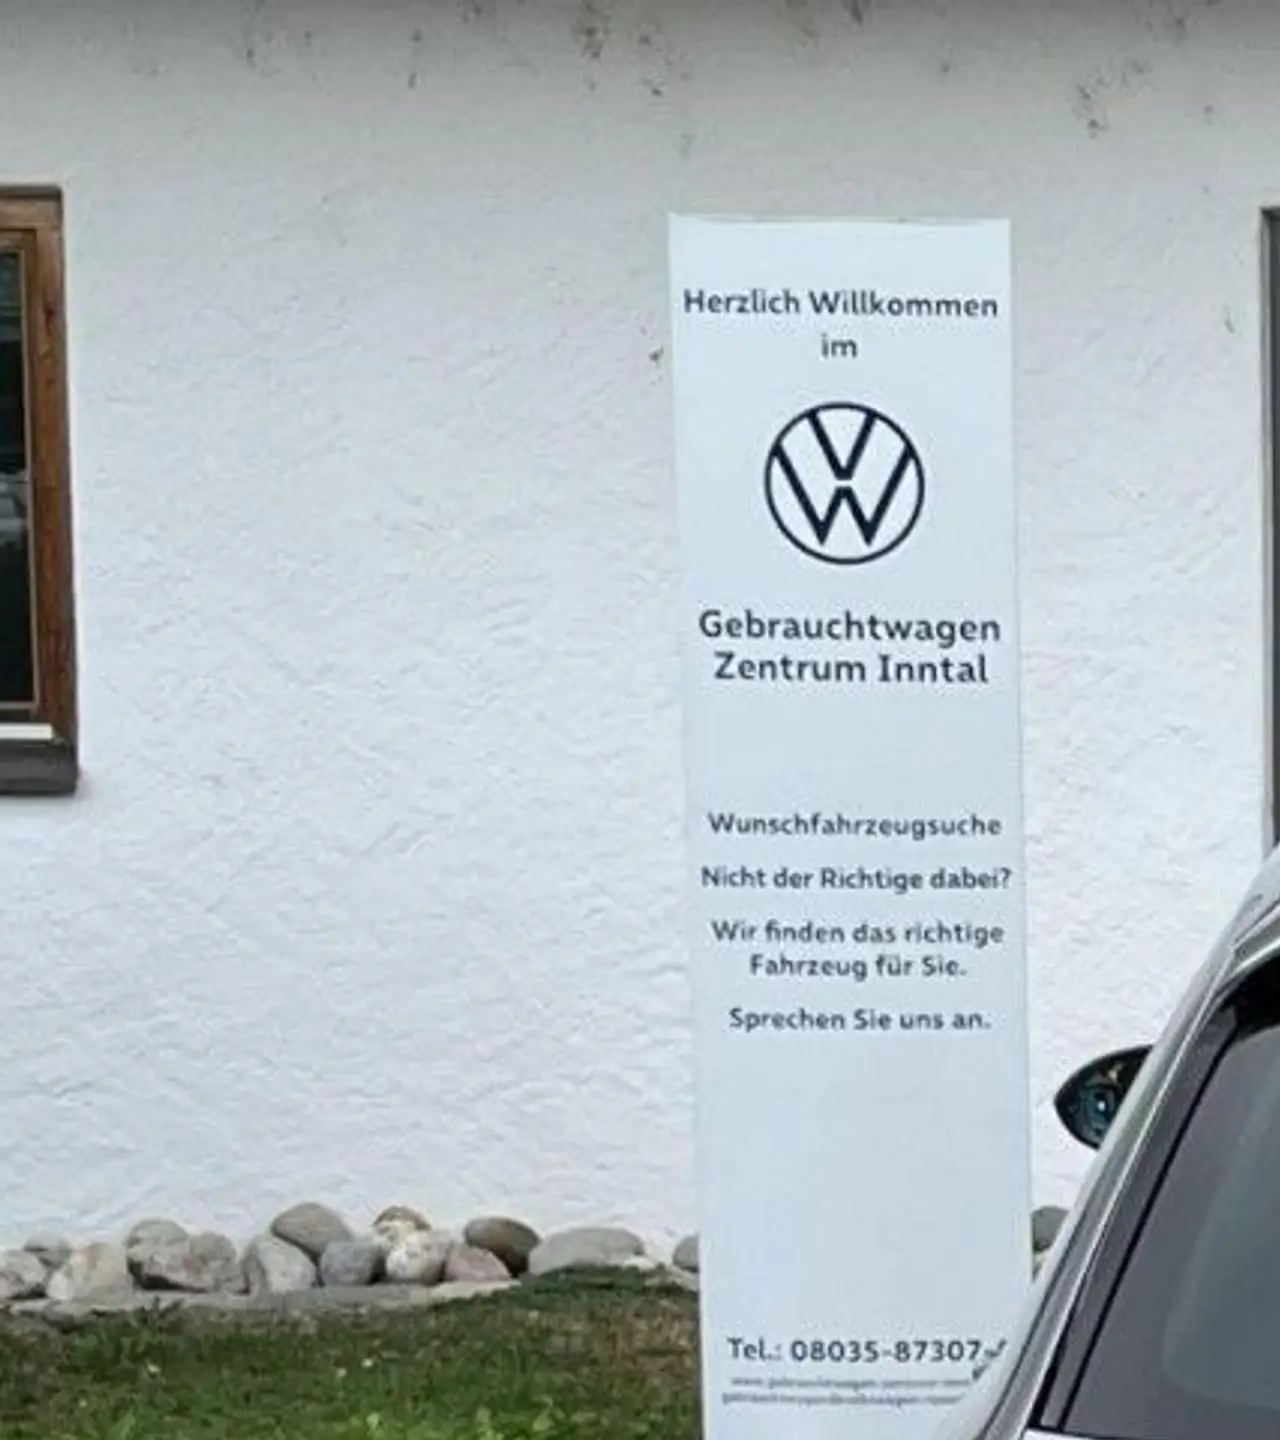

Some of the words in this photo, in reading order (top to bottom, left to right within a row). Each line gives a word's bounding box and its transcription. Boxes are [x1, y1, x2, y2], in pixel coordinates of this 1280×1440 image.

[683, 287, 801, 316] Herzlich
[807, 289, 998, 319] Willkommen
[821, 332, 858, 360] im
[763, 400, 926, 566] VW
[698, 608, 1001, 649] Gebrauchtwagen
[714, 651, 867, 683] Zentrum
[878, 653, 989, 684] Inntal
[707, 811, 1003, 841] Wunschfahrzeugsuche
[701, 865, 767, 889] Nicht
[772, 866, 814, 890] der
[819, 866, 924, 894] Richtige
[929, 866, 1013, 890] dabei?
[710, 919, 758, 942] Wir
[764, 918, 846, 944] finden
[851, 922, 897, 944] das
[904, 920, 1006, 950] richtige
[749, 952, 869, 983] Fahrzeug
[874, 953, 914, 977] für
[921, 954, 968, 978] Sie.
[728, 1006, 846, 1034] Sprechen
[853, 1007, 893, 1031] Sie
[899, 1013, 945, 1031] uns
[951, 1012, 992, 1031] an.
[726, 1337, 783, 1362] Tel.:
[789, 1338, 1008, 1364] 08035-87307-
